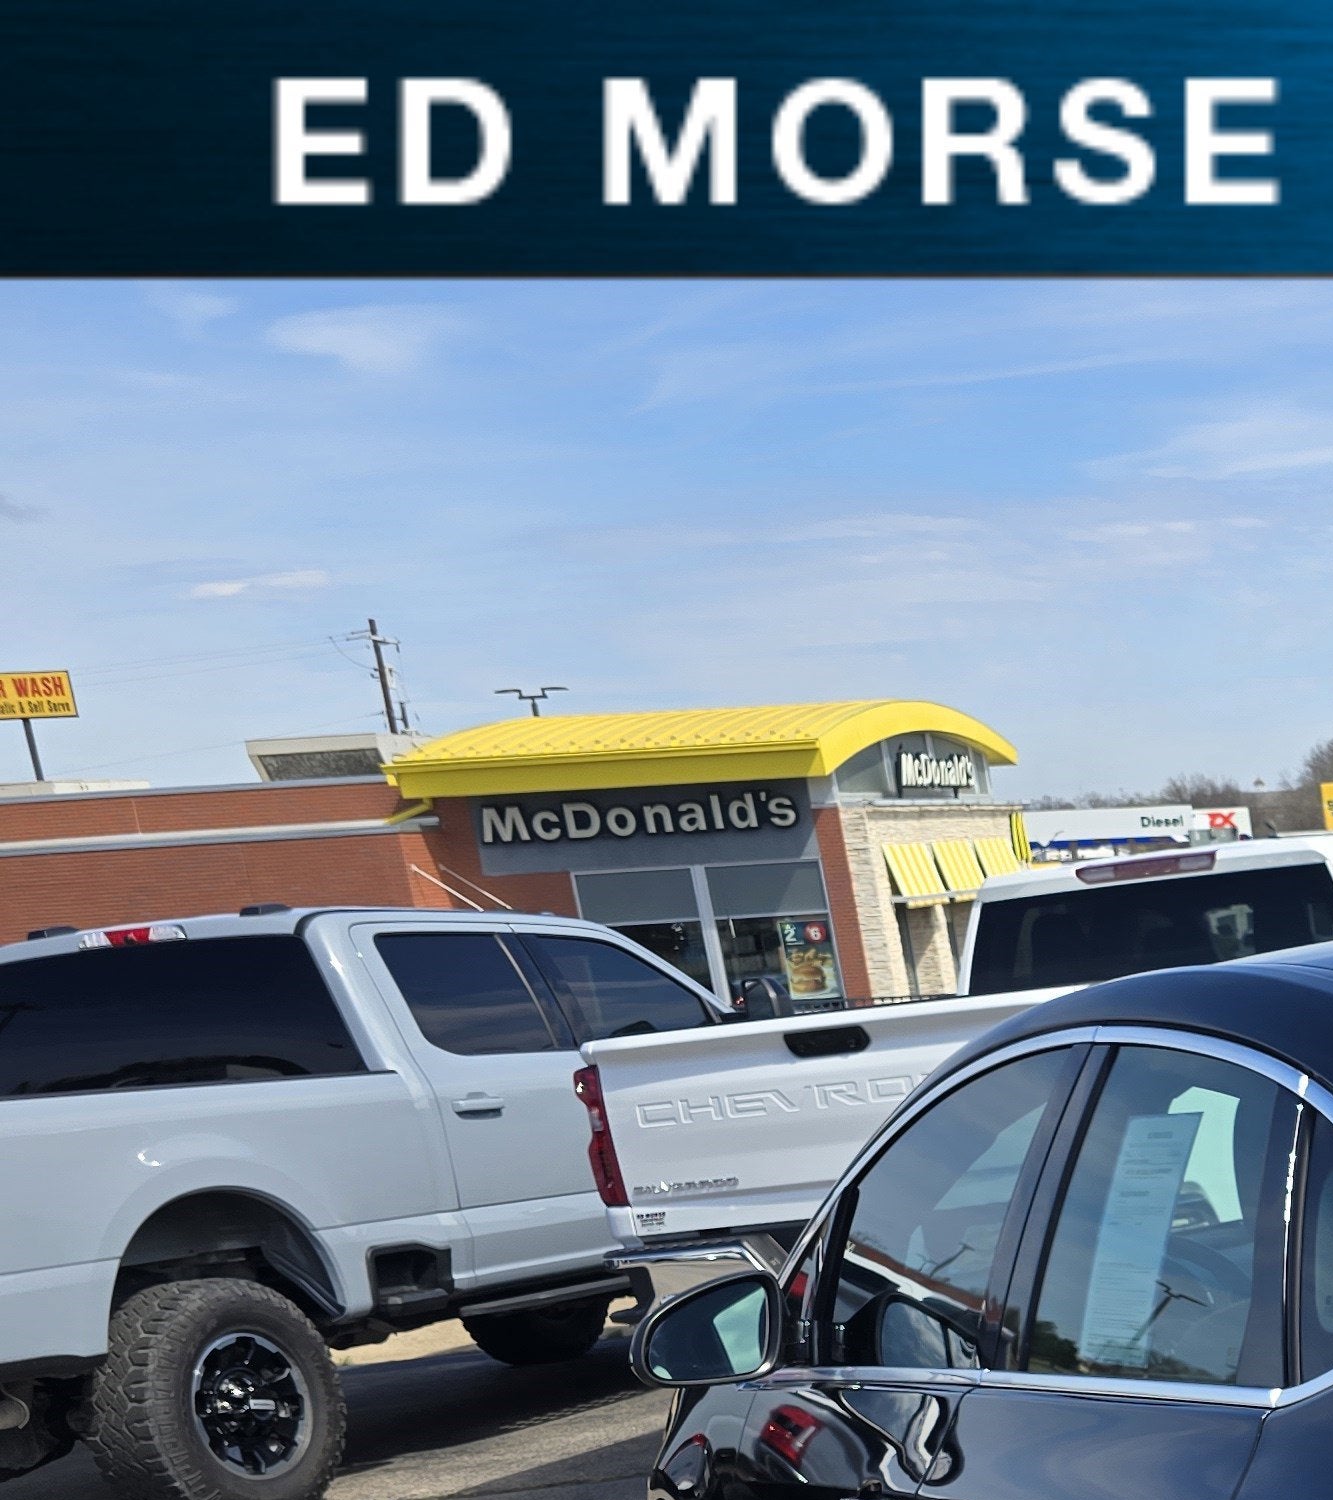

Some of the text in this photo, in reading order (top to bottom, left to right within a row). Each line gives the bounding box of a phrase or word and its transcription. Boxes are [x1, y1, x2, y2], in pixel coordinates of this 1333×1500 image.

[12, 677, 66, 697] WASH
[901, 752, 976, 787] McDonald's
[482, 792, 797, 843] McDonald's
[1141, 814, 1184, 828] Diesel
